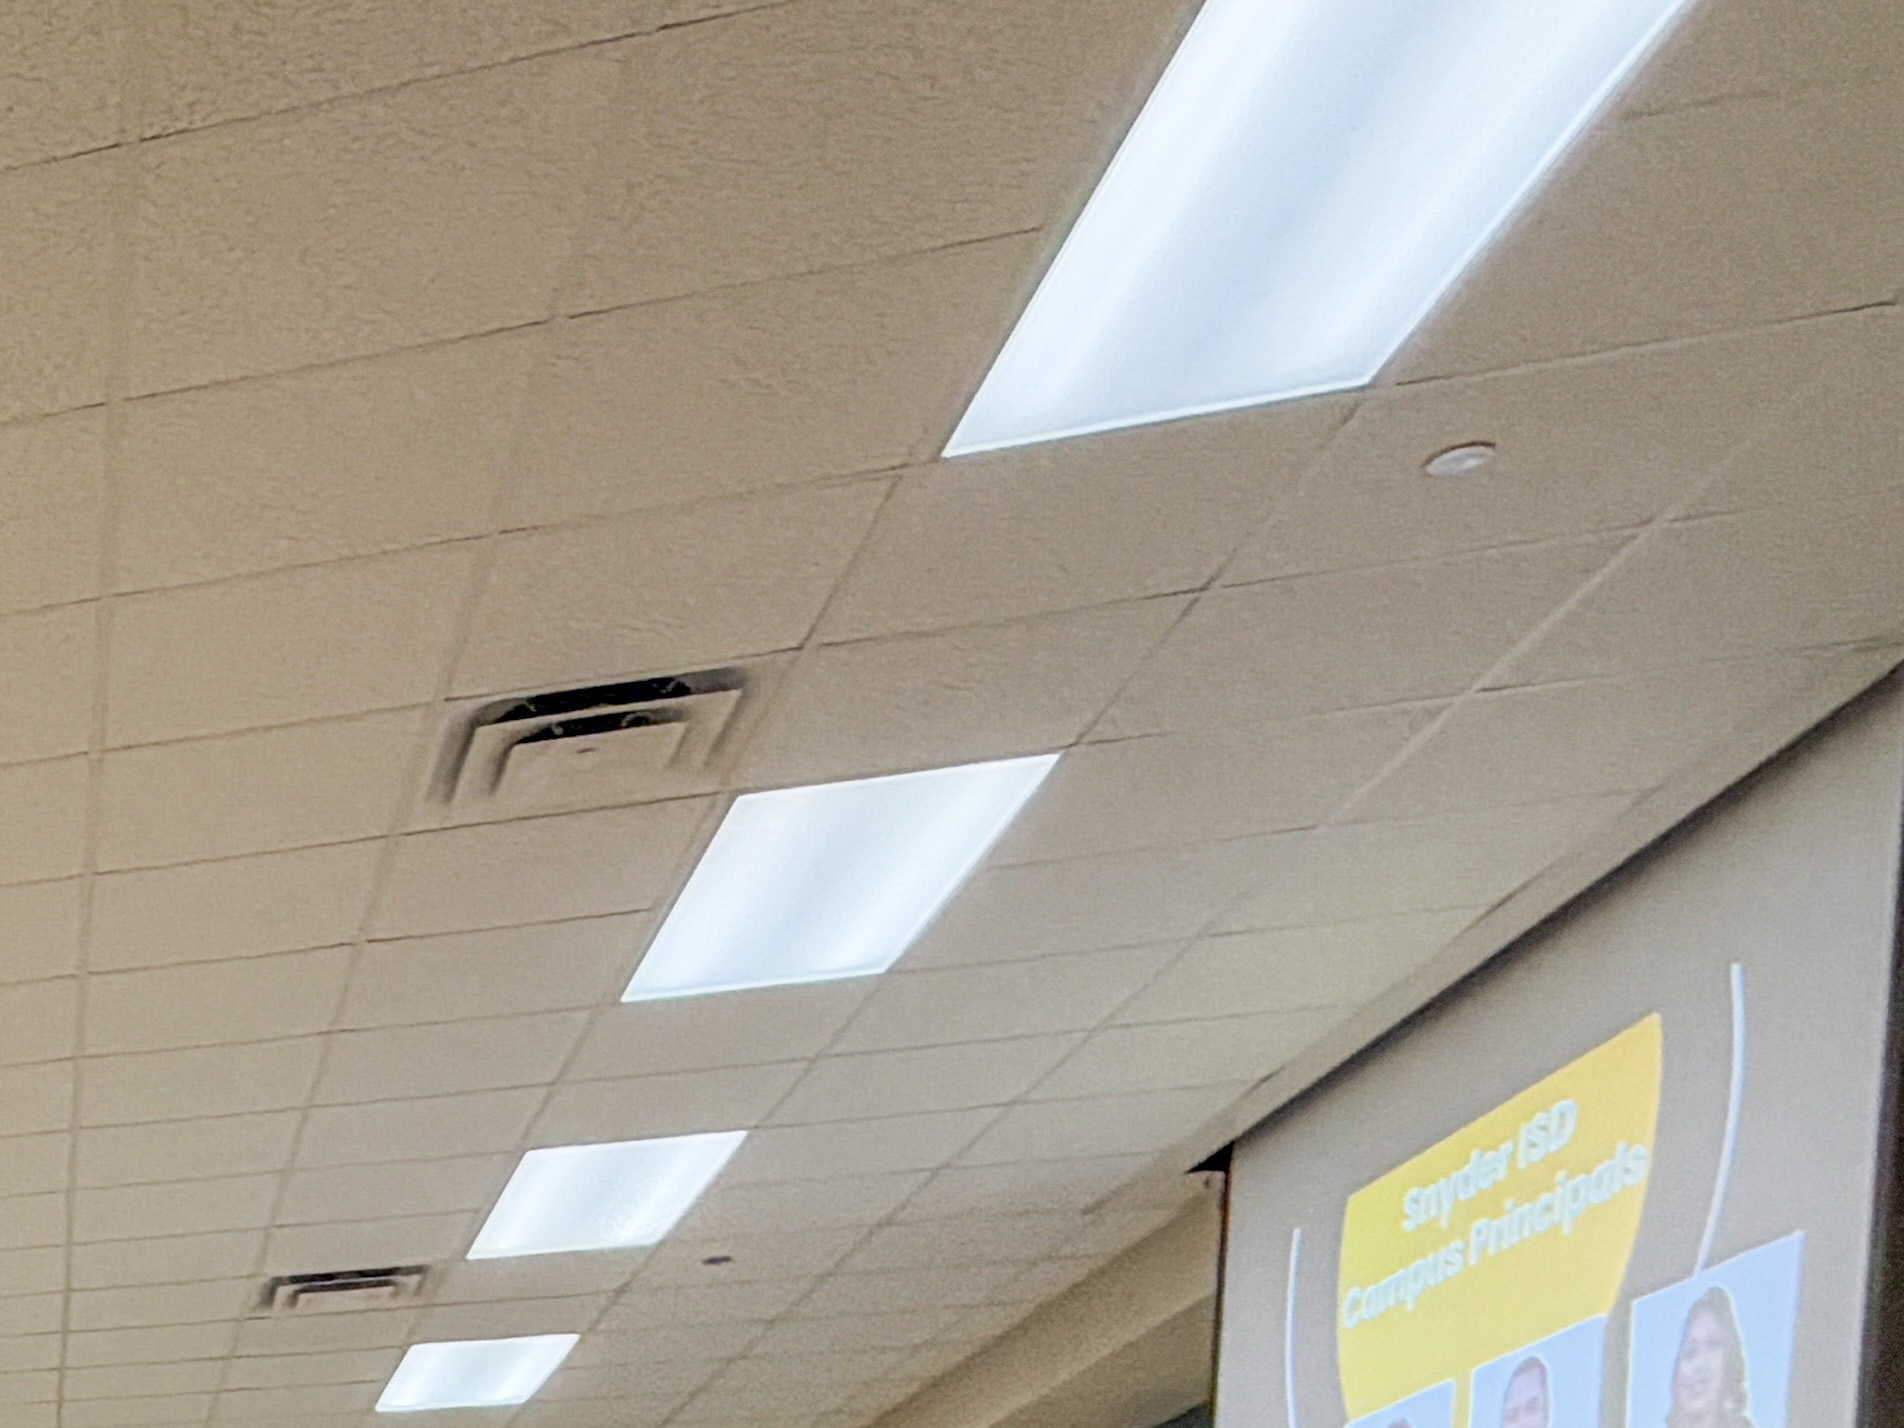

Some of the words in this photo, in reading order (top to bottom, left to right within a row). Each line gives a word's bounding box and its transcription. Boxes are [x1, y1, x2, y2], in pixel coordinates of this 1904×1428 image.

[1343, 1239, 1465, 1329] Campus
[1467, 1140, 1649, 1266] Principals
[1402, 1140, 1514, 1231] Snyder
[1517, 1098, 1578, 1165] ISD
